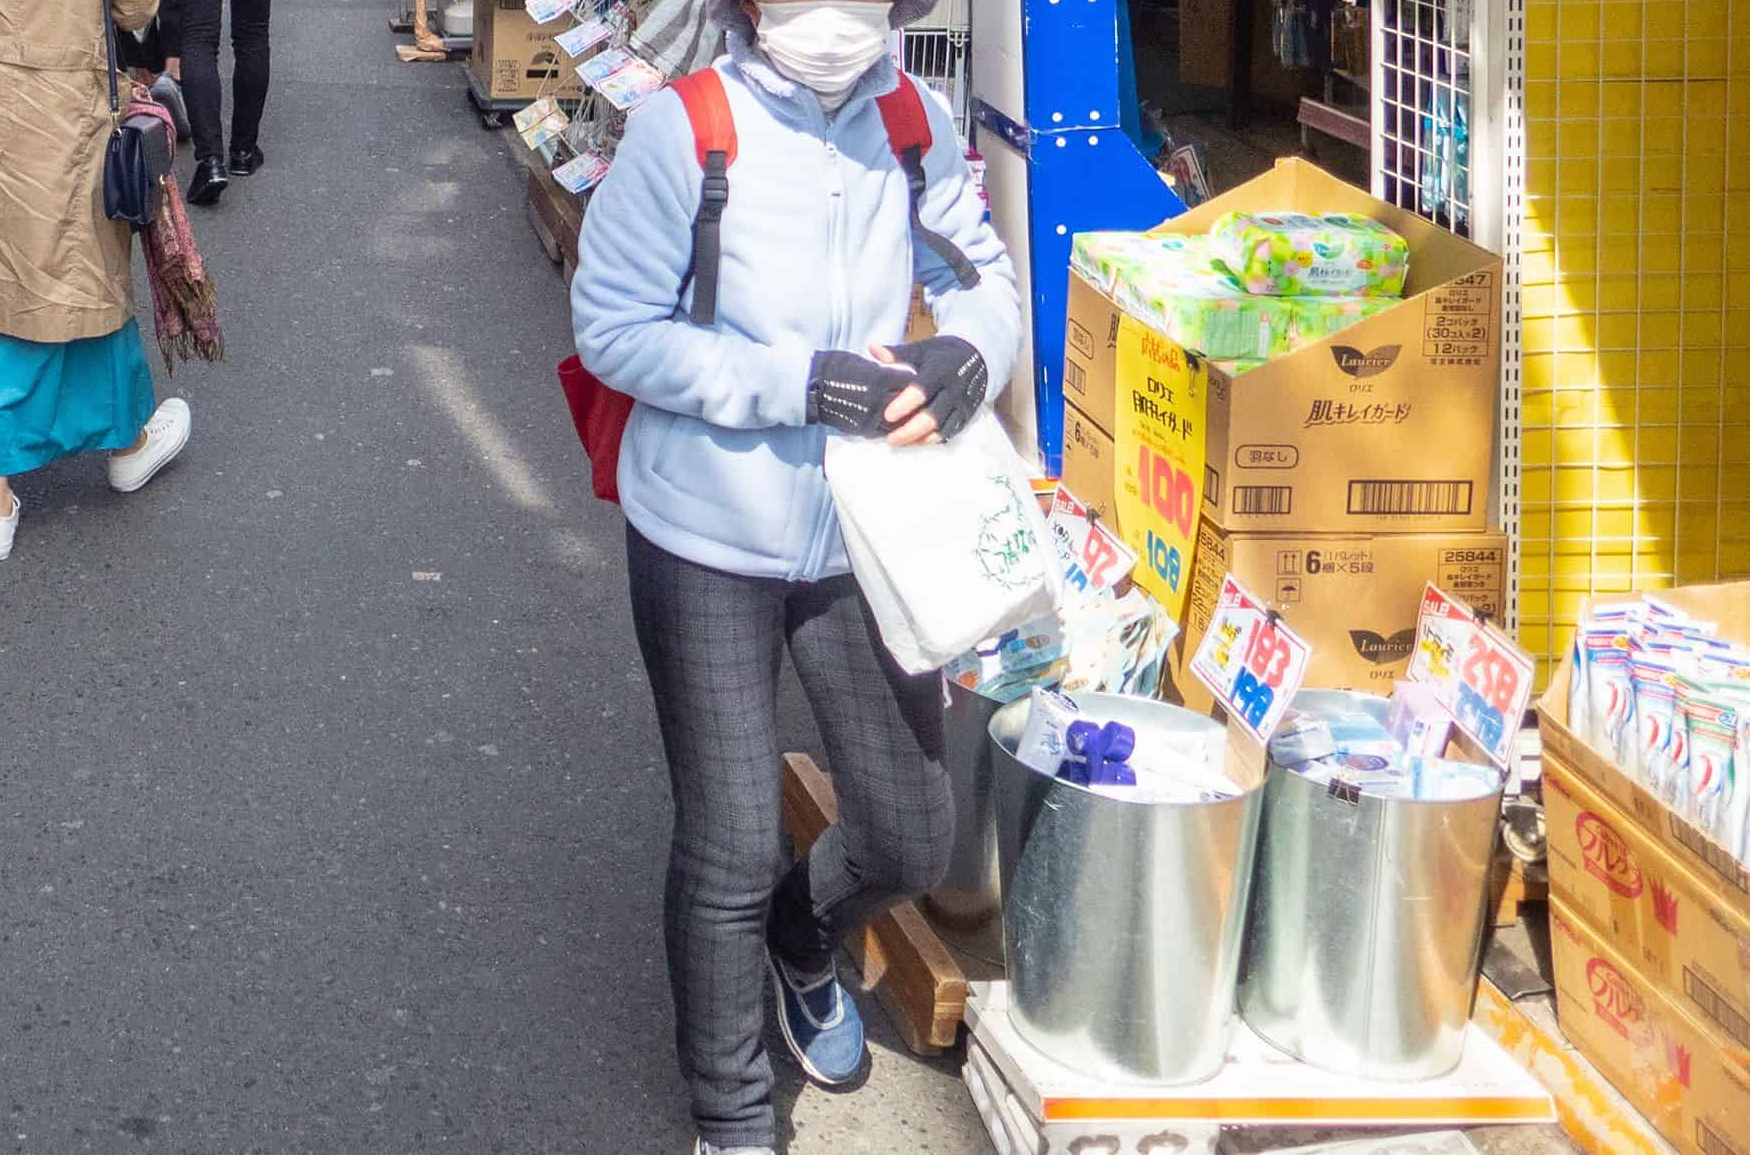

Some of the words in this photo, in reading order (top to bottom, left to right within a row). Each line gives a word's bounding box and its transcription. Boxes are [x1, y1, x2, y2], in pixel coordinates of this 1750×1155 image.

[1435, 316, 1479, 327] 2コパック
[1434, 343, 1478, 355] 12パック
[1339, 353, 1392, 369] Laurier
[1146, 376, 1175, 404] ロリエ
[1348, 383, 1375, 393] ロリエ
[1304, 398, 1412, 428] 肌キレイガード
[1249, 449, 1289, 464] 羽なし
[1137, 442, 1196, 541] 100
[1146, 529, 1182, 595] 108
[1305, 549, 1322, 575] 6
[1369, 670, 1396, 680] ロリエ
